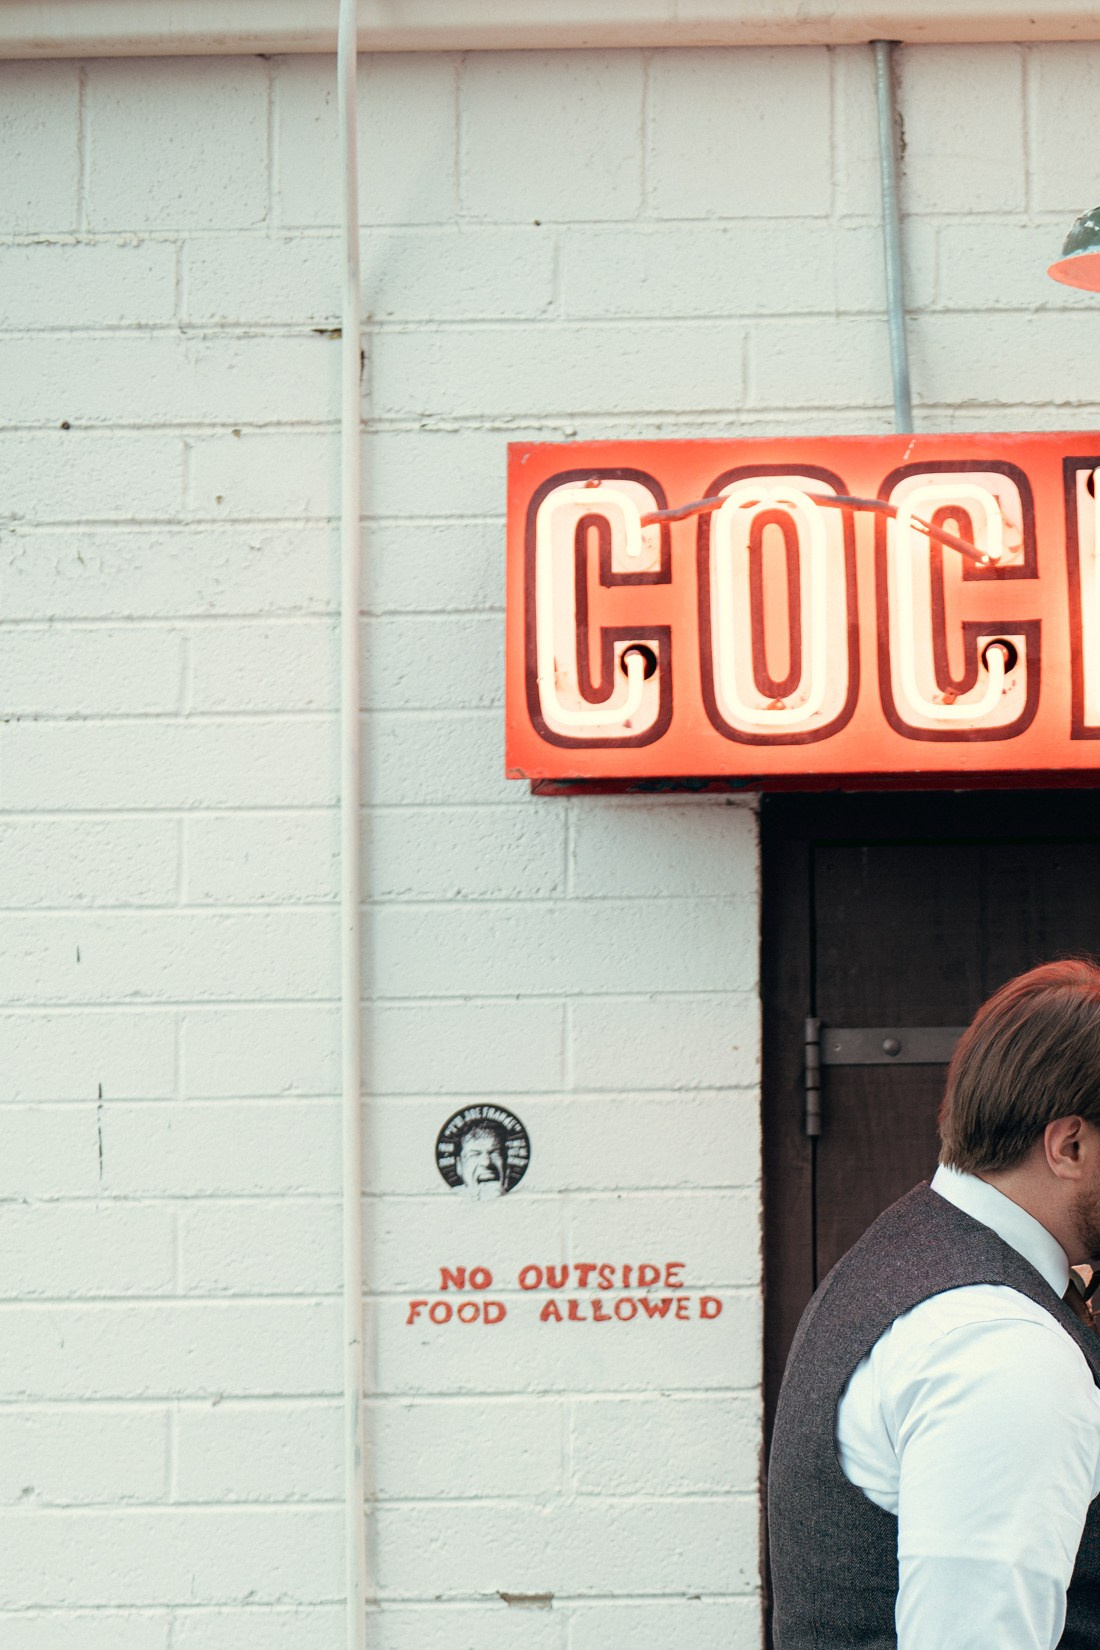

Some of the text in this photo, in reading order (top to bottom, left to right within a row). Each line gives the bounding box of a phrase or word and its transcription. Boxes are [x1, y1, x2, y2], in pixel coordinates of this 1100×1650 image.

[440, 1262, 684, 1290] NO OUTSIDE
[407, 1296, 722, 1325] FOOD ALLOWED
